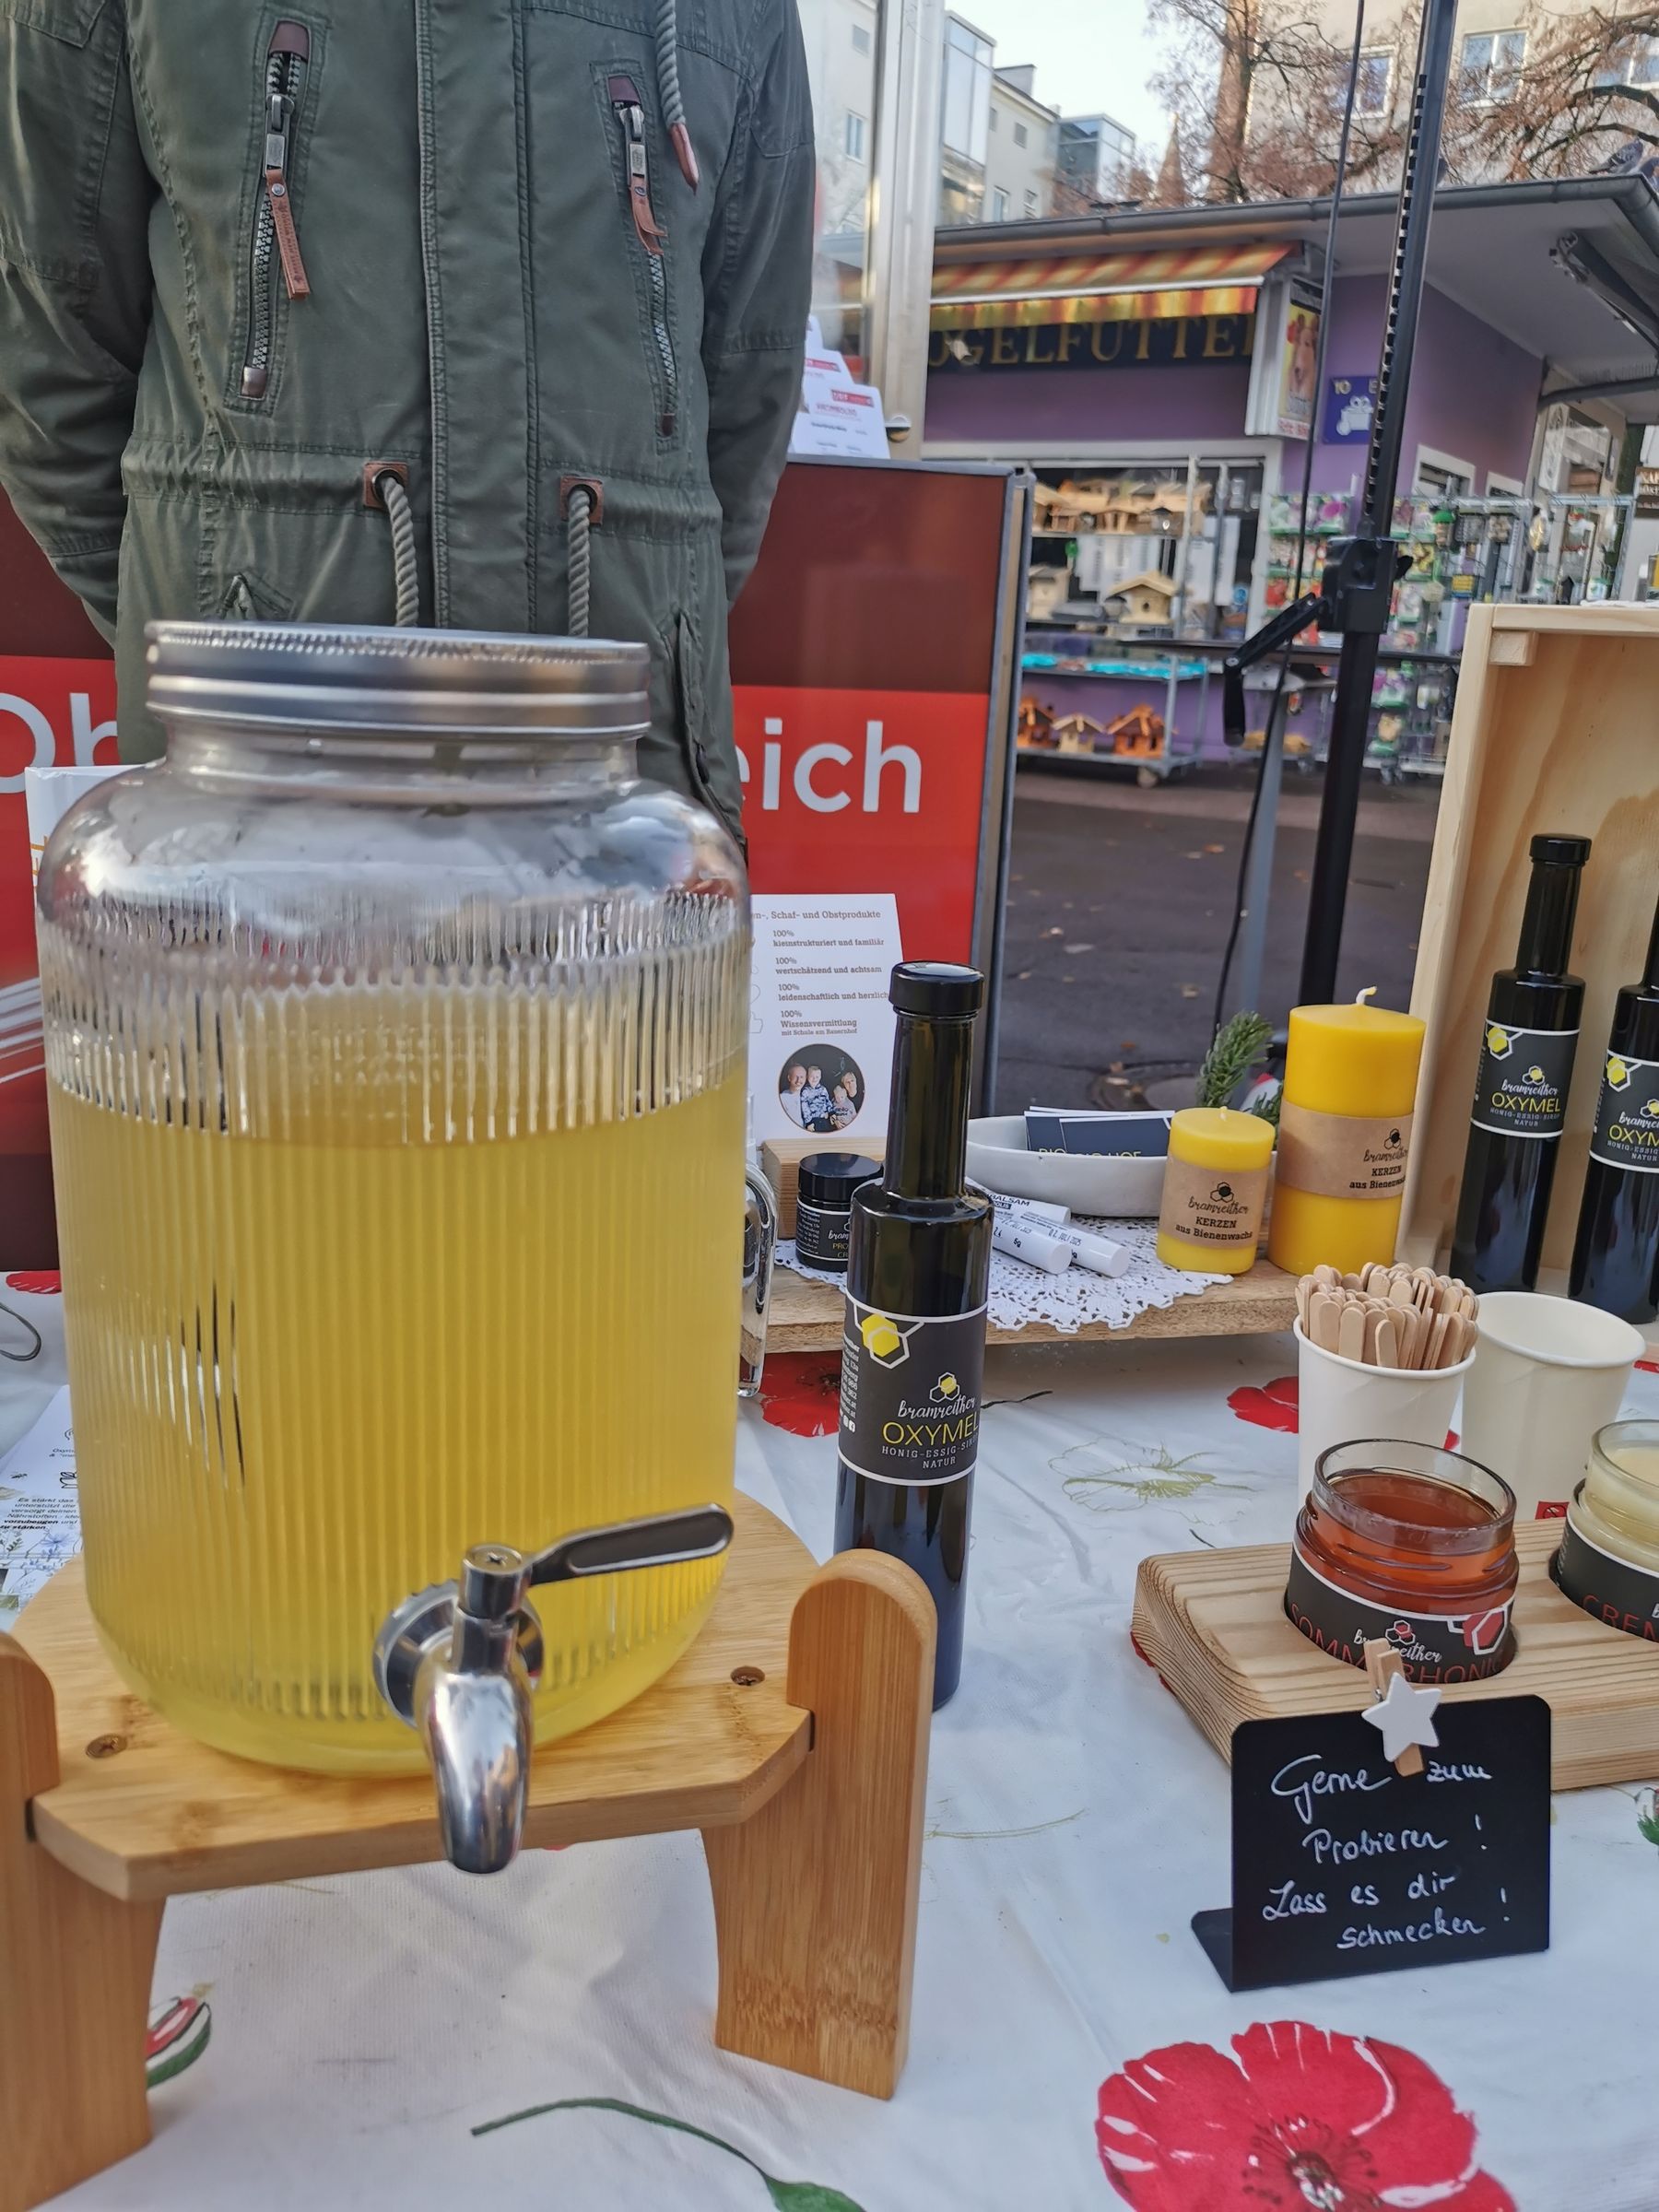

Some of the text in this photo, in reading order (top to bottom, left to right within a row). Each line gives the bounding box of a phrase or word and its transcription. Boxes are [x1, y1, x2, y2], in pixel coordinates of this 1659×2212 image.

[771, 911, 800, 919] Schaf-
[803, 911, 819, 919] und
[822, 911, 881, 920] Obstprodukte
[838, 938, 853, 947] und
[775, 957, 797, 965] 100%
[775, 967, 832, 975] wertschätzend
[778, 983, 800, 992] 100%
[778, 993, 840, 1002] leidenschaftlich
[841, 992, 856, 1000] und
[781, 1019, 857, 1028] Wissensvermittlung
[1492, 1091, 1561, 1112] OXYMEL
[1514, 1119, 1539, 1127] NATUR
[1631, 1153, 1658, 1161] NATUR
[1371, 1165, 1402, 1176] KERZEN
[1349, 1181, 1367, 1189] aus
[1195, 1216, 1237, 1229] KERZEN
[1175, 1224, 1191, 1234] aus
[883, 1411, 979, 1446] OXYMEL
[923, 1456, 956, 1469] NATUR
[1270, 1754, 1393, 1825] Gerne
[1301, 1828, 1450, 1865] Probieren
[1350, 1884, 1381, 1906] es
[1407, 1870, 1456, 1900] dir
